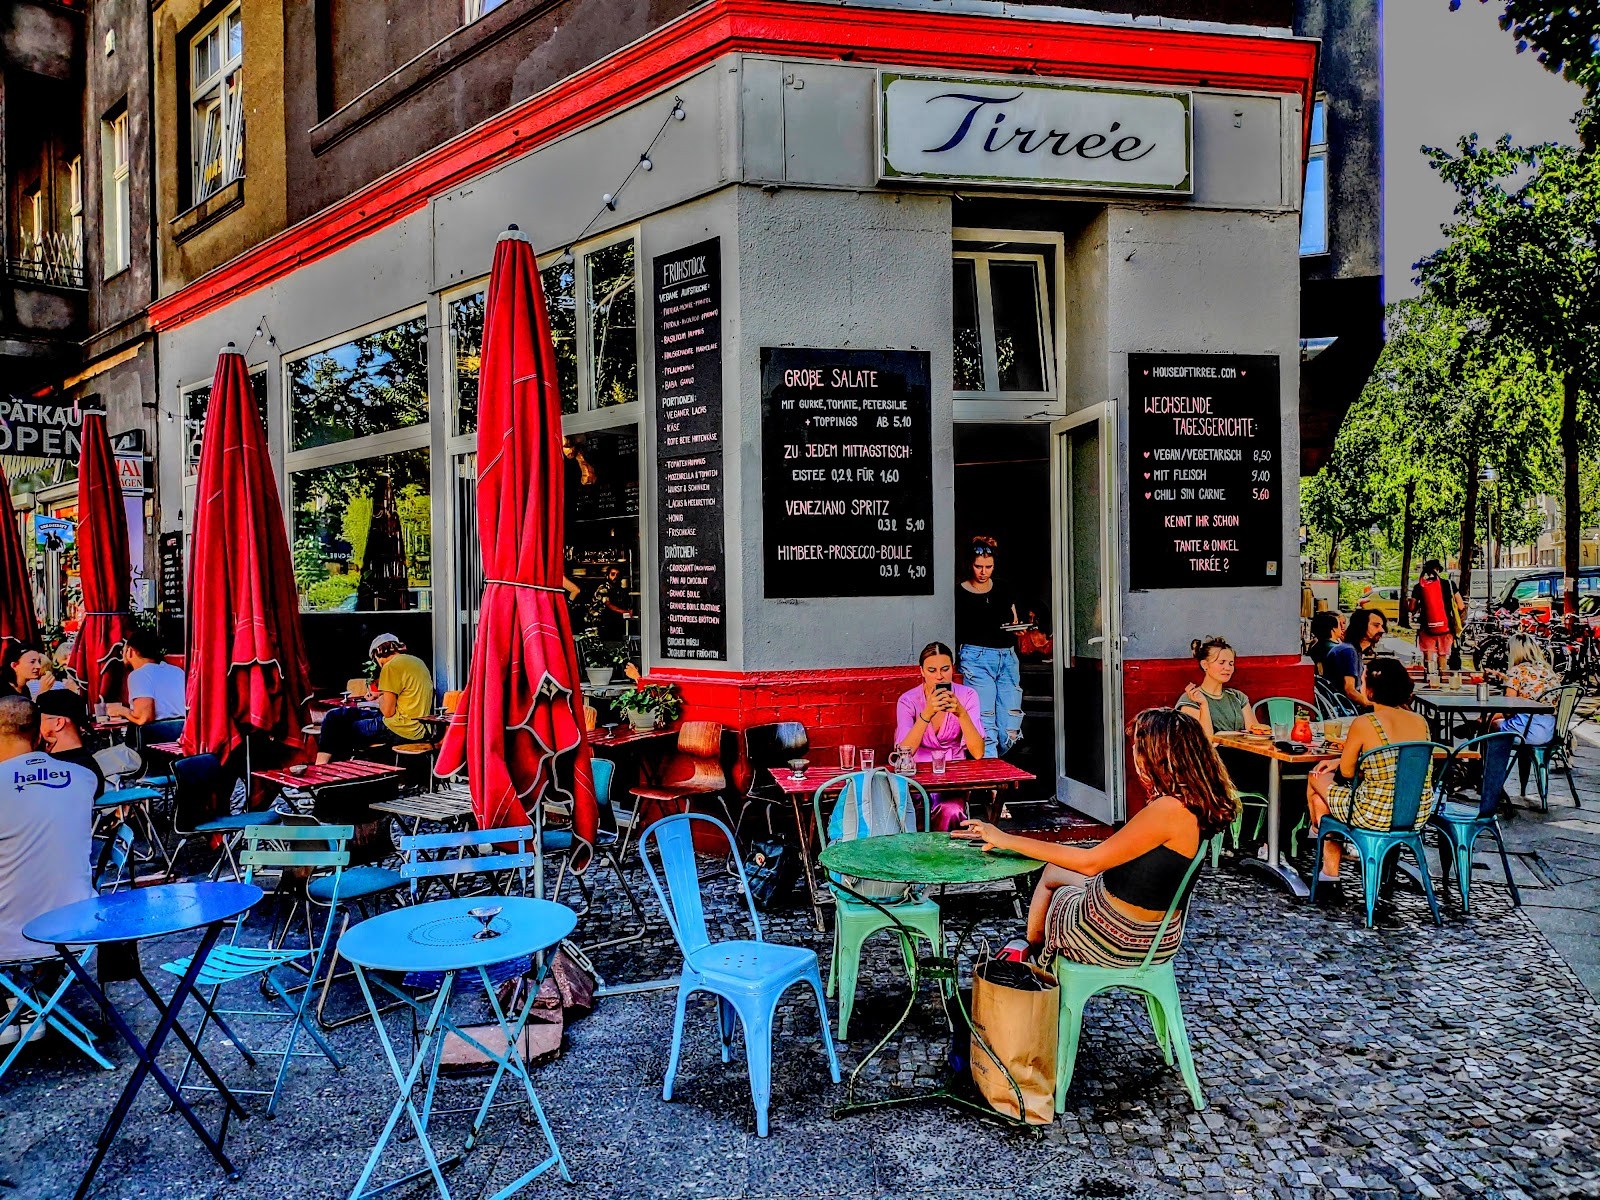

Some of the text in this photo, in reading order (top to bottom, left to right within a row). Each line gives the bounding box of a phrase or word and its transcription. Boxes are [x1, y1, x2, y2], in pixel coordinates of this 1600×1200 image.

[921, 91, 1156, 161] Tirrée
[831, 369, 879, 388] SALATE
[1152, 366, 1237, 379] HOUSEOFTIRREE.COM
[665, 380, 678, 390] BABA
[781, 400, 795, 410] MIT
[862, 400, 908, 410] PETERSILIE
[1144, 396, 1213, 414] WECHSELNDE
[0, 398, 82, 427] PÄTKAU
[666, 406, 707, 420] VEGANER LACHS
[667, 422, 680, 432] KÄSE
[813, 416, 858, 427] TOPPINGS
[876, 416, 890, 428] AB
[1173, 417, 1258, 437] TAGESGERICHTE:
[784, 444, 913, 459] ZU JEDEM MITTAGSTISCH:
[1153, 449, 1272, 463] VEGAN/VEGETARISCH 8,50
[792, 469, 826, 481] EISTEE
[856, 467, 875, 482] FÜR
[1153, 469, 1170, 481] MIT
[1173, 469, 1207, 481] FLEISCH
[668, 485, 682, 493] WURST
[1154, 489, 1176, 501] CHILI
[1180, 488, 1195, 500] SIN
[1198, 488, 1226, 500] CARNE
[668, 499, 684, 508] LACHS
[785, 499, 890, 516] VENEZIANO SPRITZ
[668, 513, 683, 522] HONIG
[1164, 515, 1240, 528] KENNT IHR SCHON
[1174, 539, 1239, 552] TANTE & ONKEL
[778, 545, 913, 560] HIMBEER-PROSECCO-BOWLE
[14, 768, 71, 788] halley
